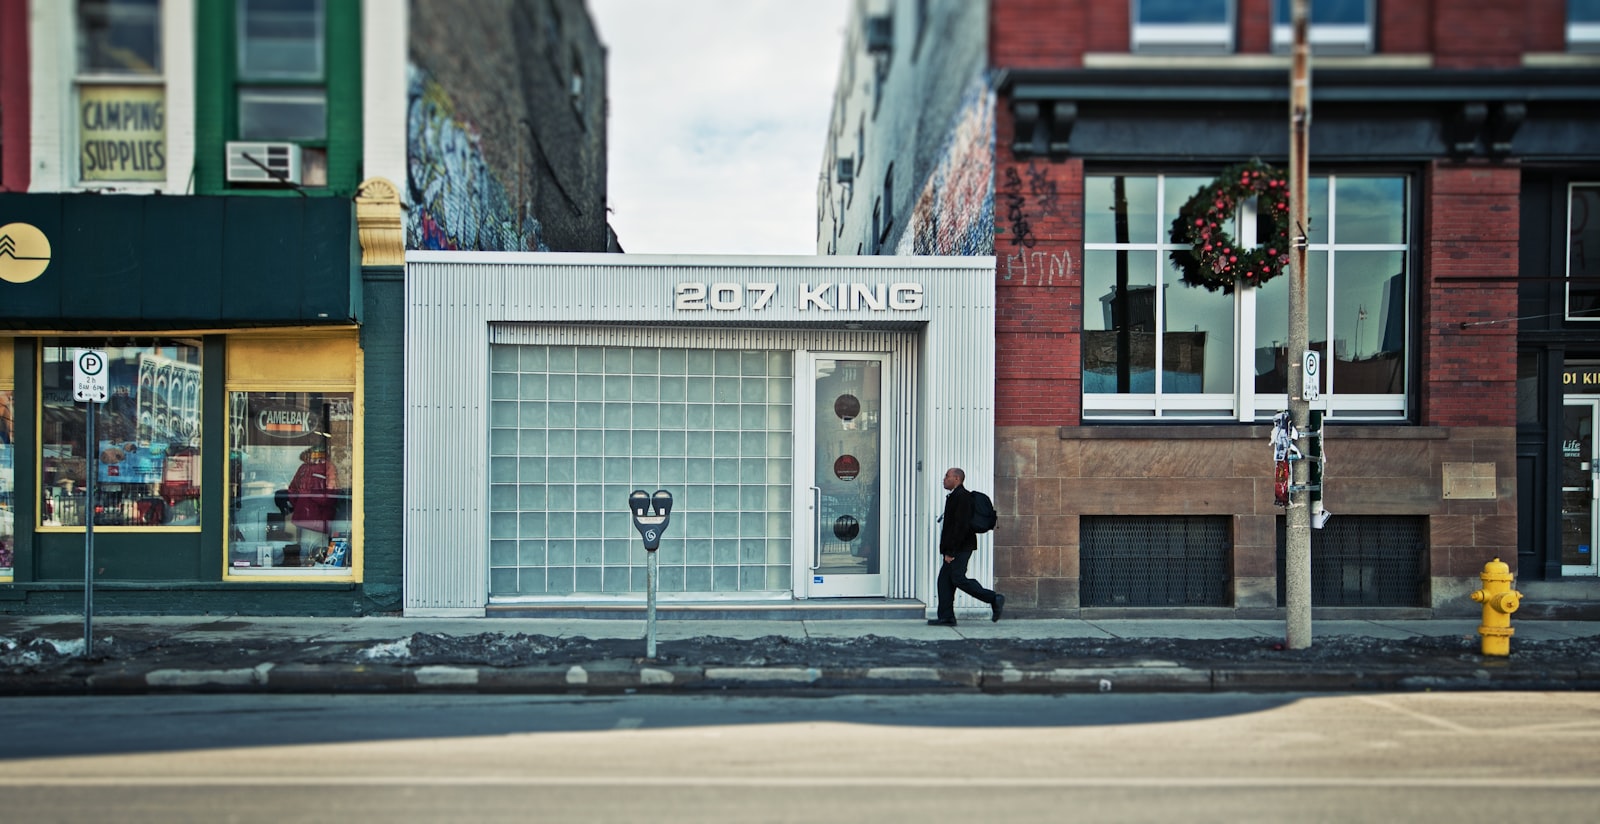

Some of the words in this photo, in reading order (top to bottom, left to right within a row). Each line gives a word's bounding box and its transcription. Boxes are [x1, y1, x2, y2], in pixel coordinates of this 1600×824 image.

[83, 101, 164, 131] CAMPING
[84, 140, 166, 171] SUPPLIES
[676, 282, 777, 311] 207
[799, 282, 924, 311] KING
[86, 358, 96, 370] P
[1582, 372, 1600, 385] KI
[259, 410, 310, 431] CAMELBAK
[1562, 440, 1581, 450] Life
